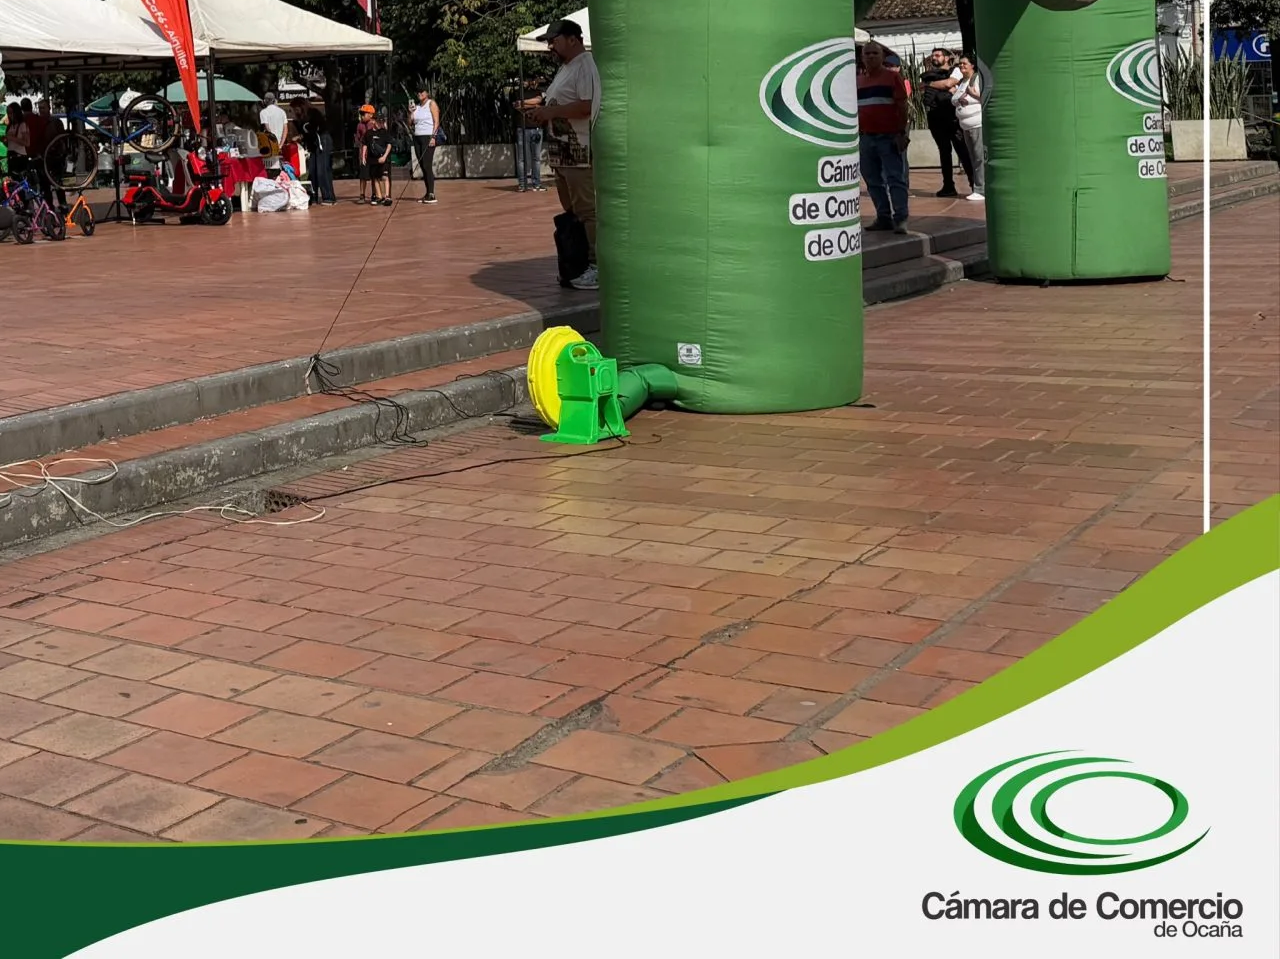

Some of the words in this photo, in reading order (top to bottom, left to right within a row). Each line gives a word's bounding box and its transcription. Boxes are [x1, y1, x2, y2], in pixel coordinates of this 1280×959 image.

[1130, 139, 1145, 153] de
[1139, 161, 1154, 176] de
[792, 198, 820, 220] de
[808, 234, 833, 257] de
